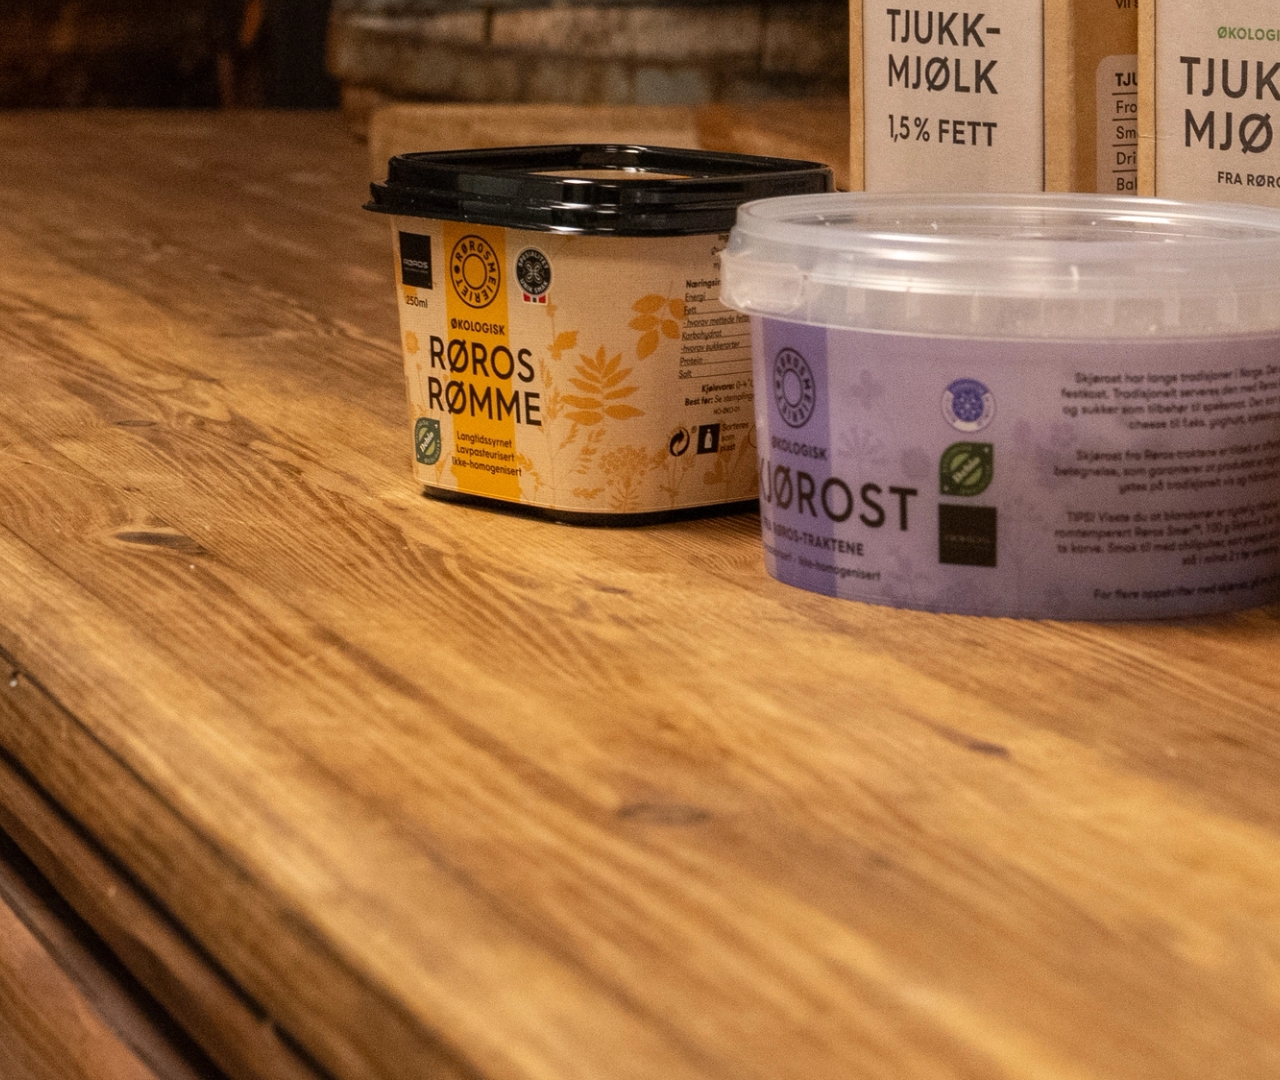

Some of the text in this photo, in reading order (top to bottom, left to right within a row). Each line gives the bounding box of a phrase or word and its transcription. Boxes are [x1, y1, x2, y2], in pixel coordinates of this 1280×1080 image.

[886, 8, 1001, 49] TJUKK-
[888, 54, 998, 95] MJØLK
[938, 119, 998, 147] FETT
[1217, 171, 1243, 186] FRA
[455, 240, 497, 303] RØROSMEIERIET
[406, 295, 429, 309] 250ml
[685, 291, 706, 302] Energi
[451, 318, 506, 336] ØKOLOGISK
[682, 330, 722, 341] Karbohydrat
[430, 335, 535, 383] RØROS
[680, 357, 703, 367] Protein
[678, 369, 692, 379] Salt
[428, 376, 543, 427] RØMME
[685, 397, 700, 407] Best
[722, 421, 749, 432] Sorteres
[457, 430, 513, 449] Langtidssyrnet
[721, 434, 735, 442] som
[456, 444, 515, 463] Lavpasteurisert
[452, 456, 522, 476] Ikke-homogenisert
